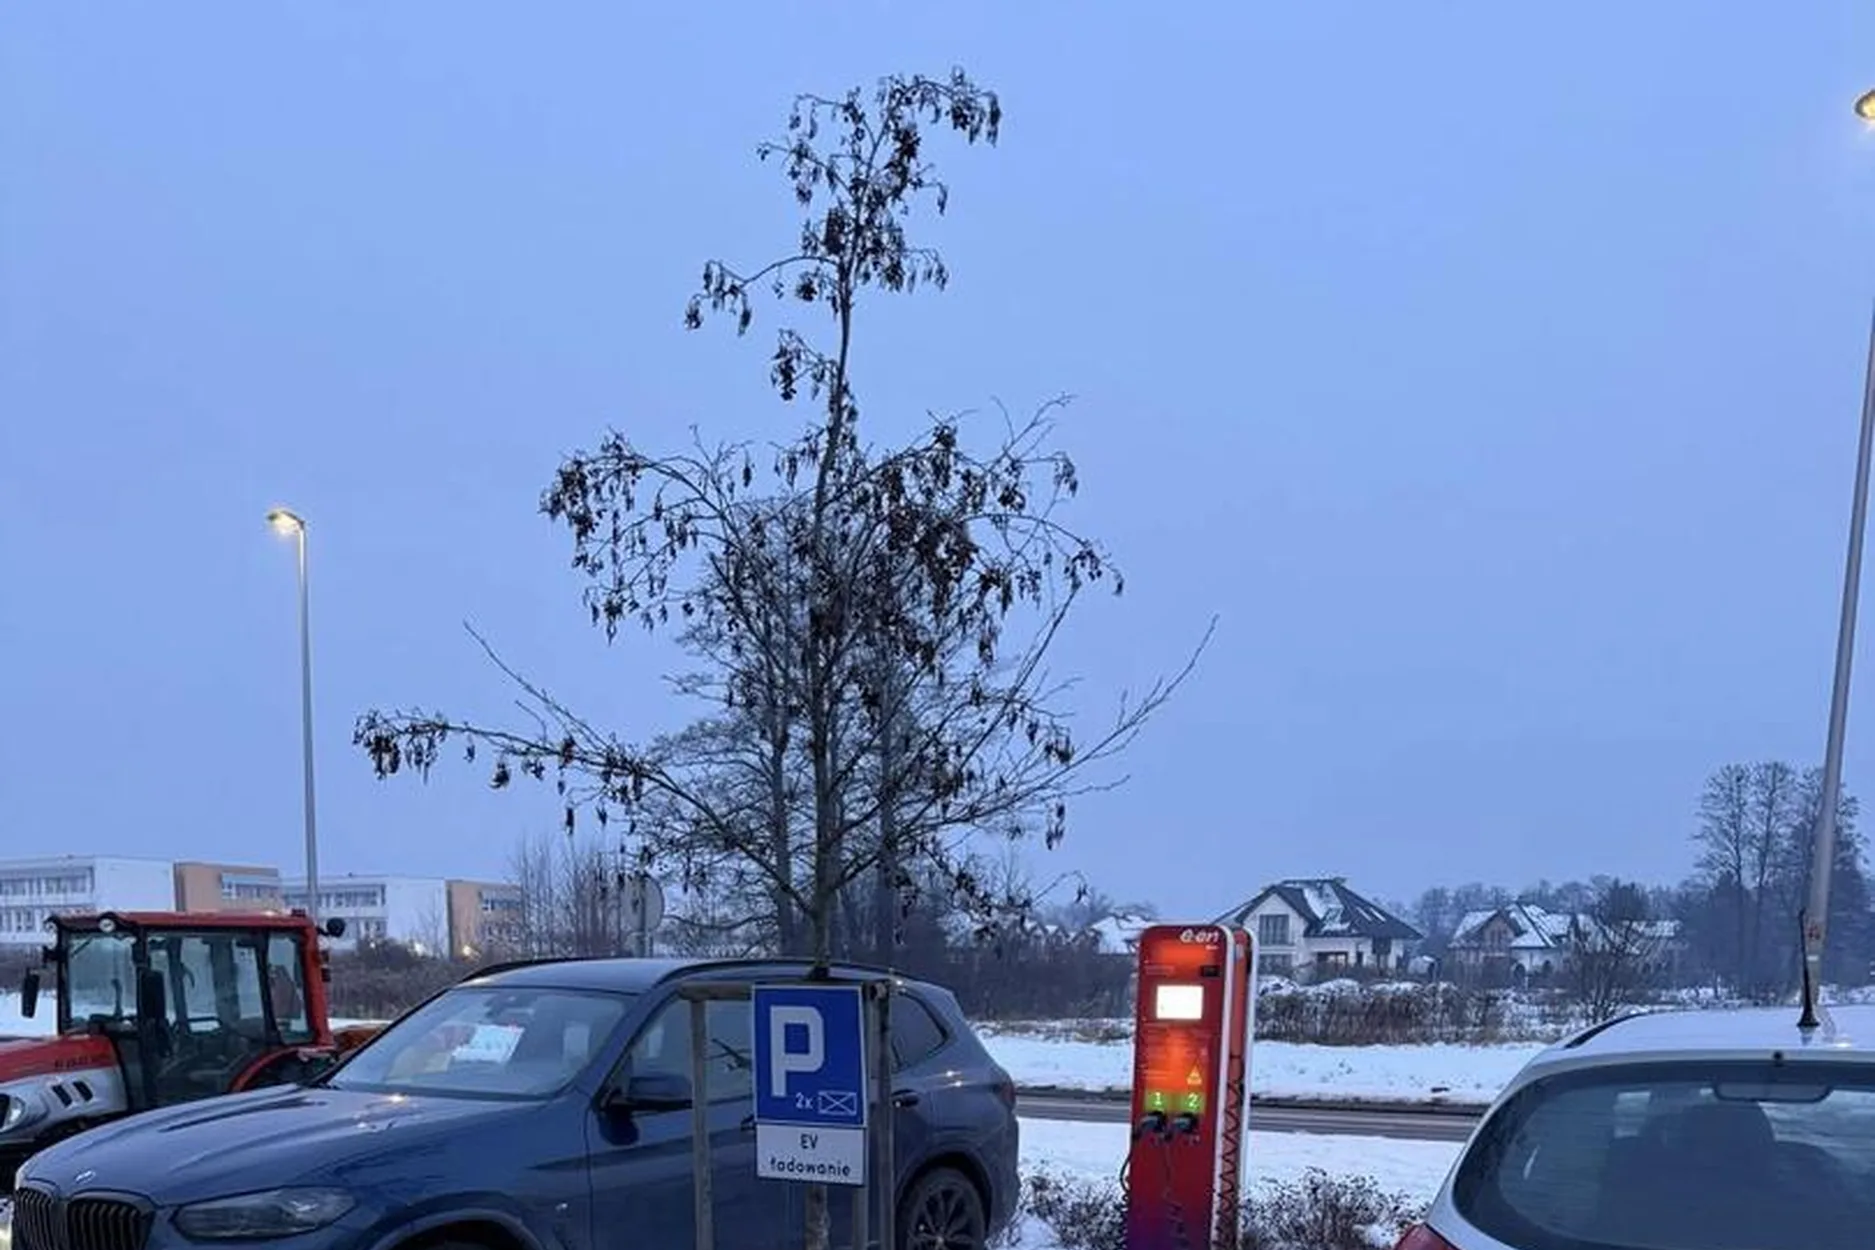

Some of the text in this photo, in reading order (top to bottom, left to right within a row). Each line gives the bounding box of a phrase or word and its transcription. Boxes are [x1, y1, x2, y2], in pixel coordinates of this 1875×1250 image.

[769, 1004, 825, 1098] P
[795, 1091, 814, 1110] 2x
[1187, 1091, 1200, 1110] 2
[800, 1132, 819, 1150] EV
